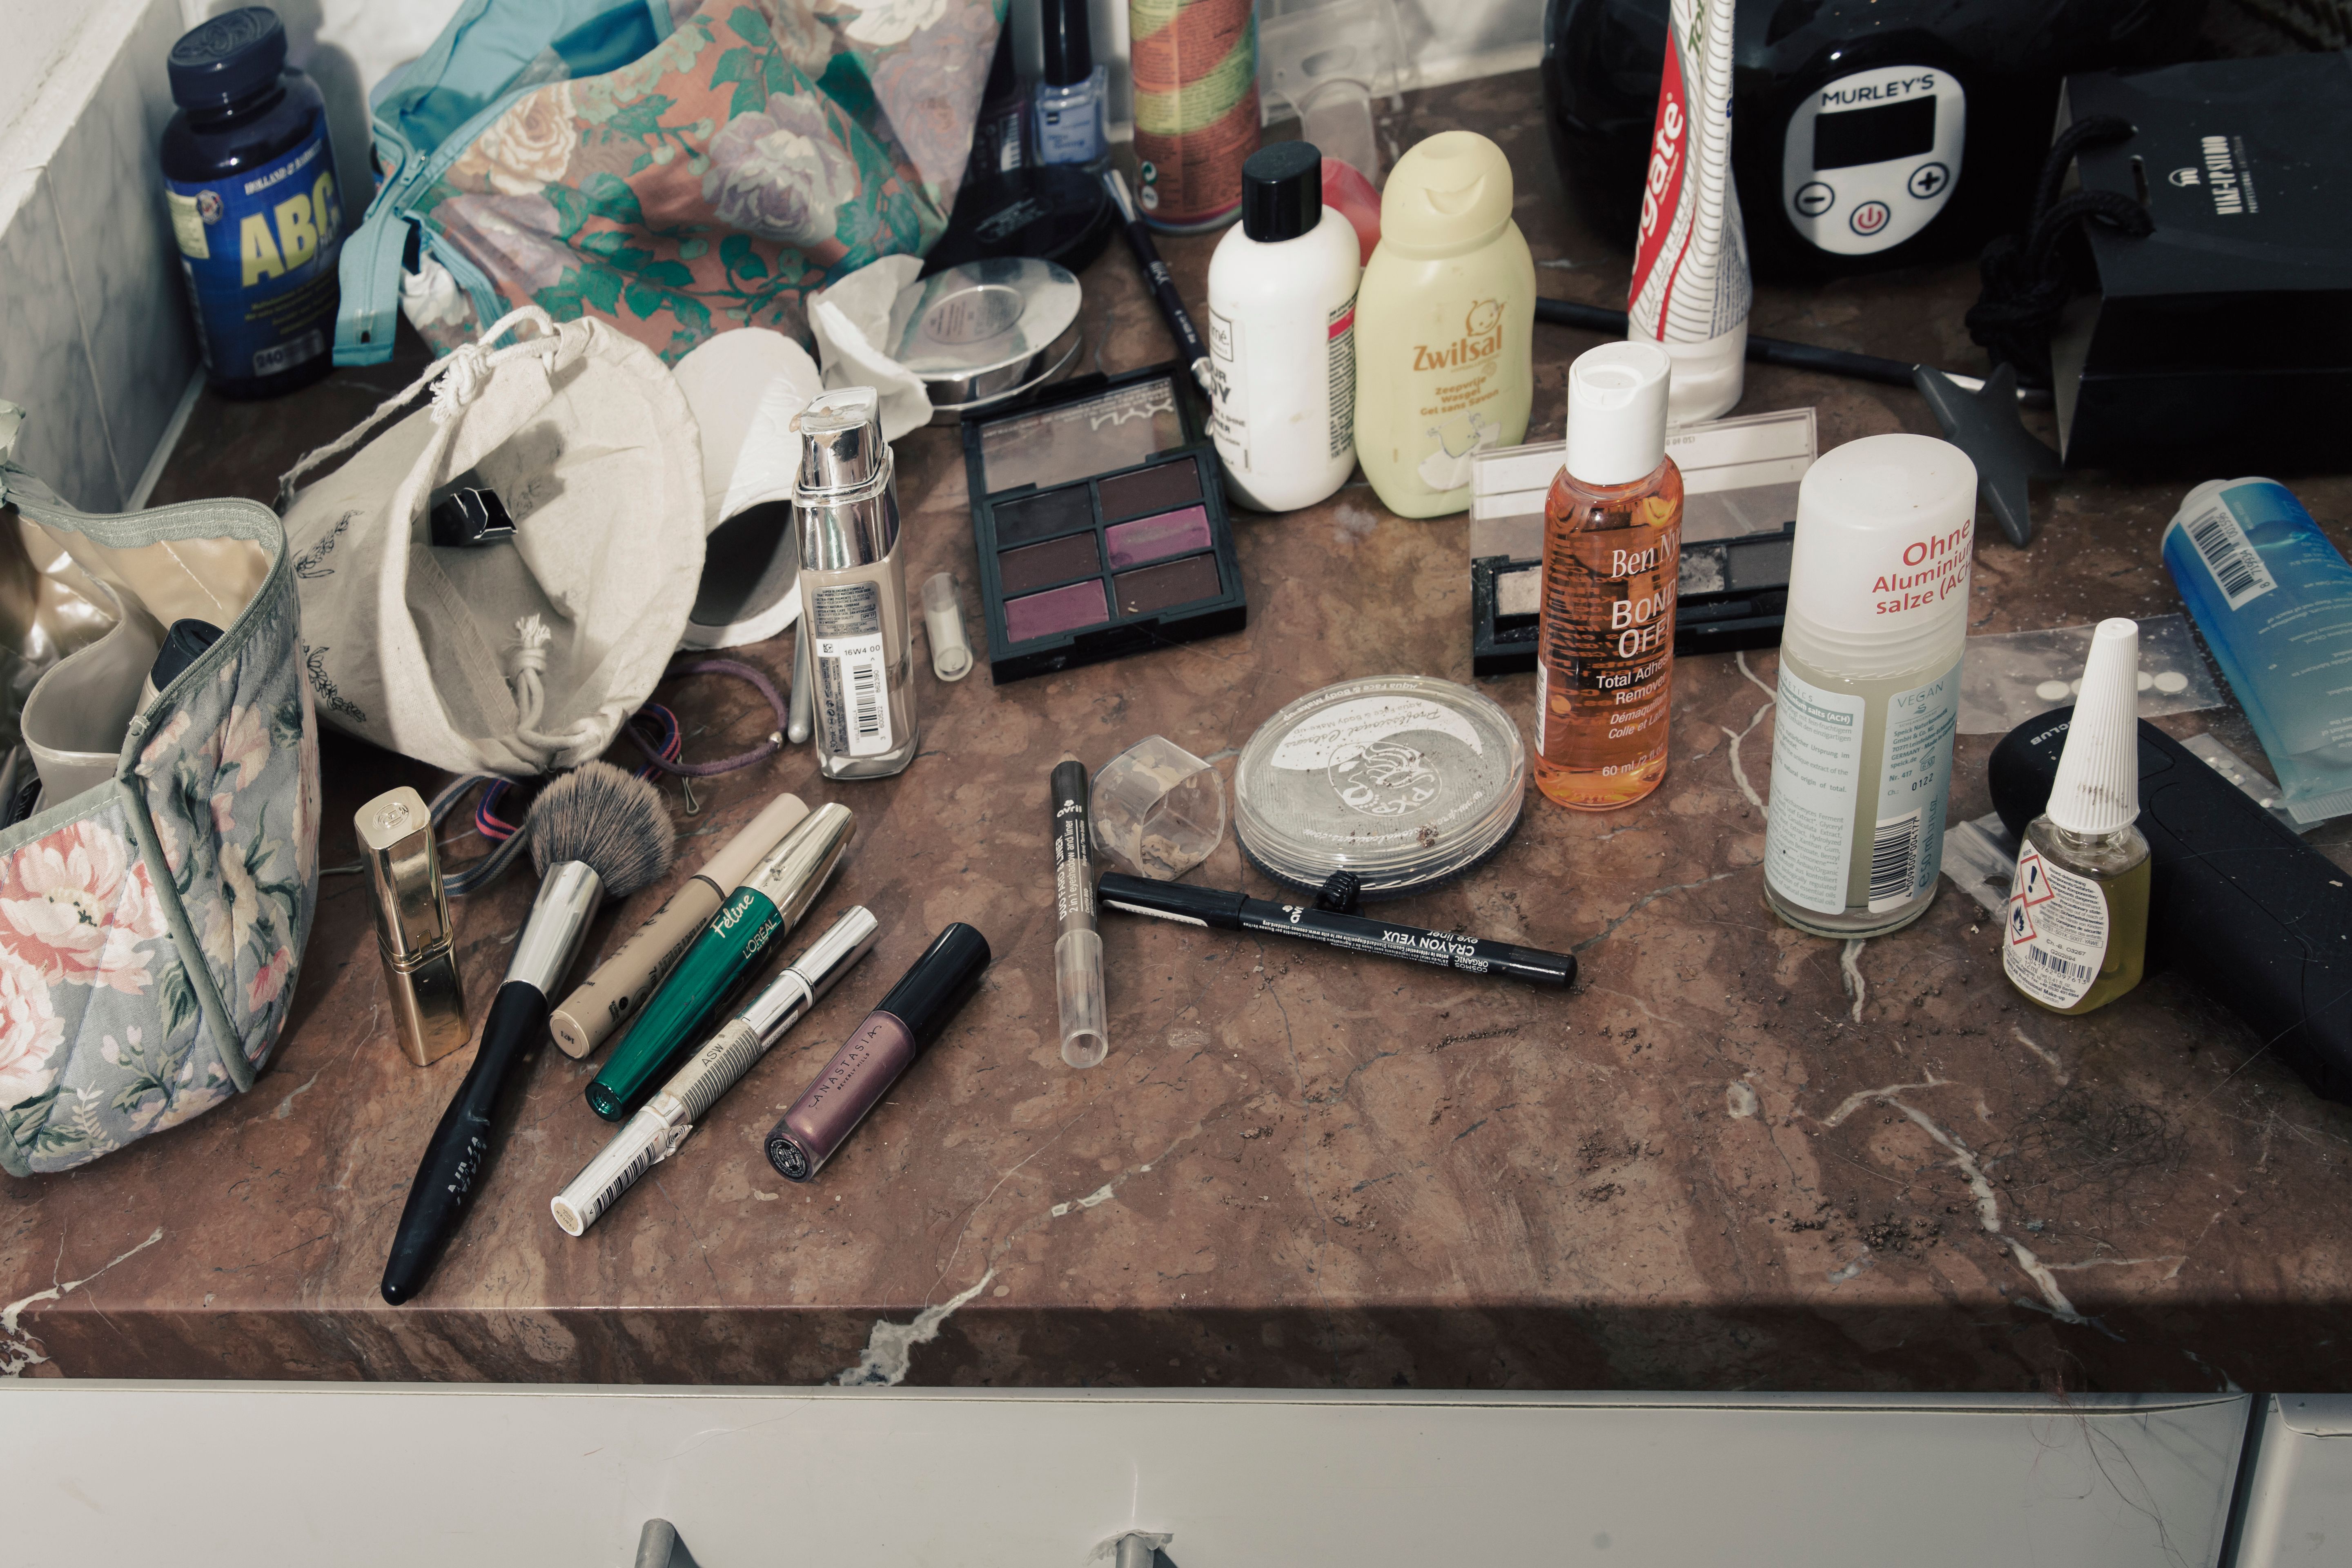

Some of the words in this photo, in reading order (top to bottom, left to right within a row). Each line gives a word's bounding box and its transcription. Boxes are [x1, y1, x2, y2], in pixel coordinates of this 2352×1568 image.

[1822, 74, 1936, 107] MURLEY'S
[240, 170, 341, 287] ABC
[1413, 325, 1503, 372] Zwitsal
[1903, 519, 1971, 566] Ohne
[1611, 549, 1656, 579] Ben
[1872, 535, 1974, 593] Aluminium
[2239, 548, 2261, 577] 719934
[1611, 577, 1676, 630] BOND
[1876, 590, 1934, 615] salze
[844, 646, 868, 656] 16W4
[870, 644, 881, 653] 00
[1363, 683, 1387, 693] Face
[1389, 682, 1417, 690] Aqua
[1596, 670, 1631, 689] Total
[1323, 686, 1350, 701] Body
[1615, 673, 1667, 705] Remover
[1897, 680, 1946, 708] VEGAN
[1281, 697, 1322, 722] Make-up
[1807, 707, 1826, 718] salts
[1826, 712, 1851, 725] (ACH)
[1608, 725, 1635, 740] Colle
[1637, 721, 1648, 733] et
[1812, 729, 1851, 744] einzigartigen
[1892, 735, 1912, 744] GmbH
[1893, 727, 1913, 737] Speick
[2029, 719, 2071, 746] CLUB
[1810, 745, 1838, 758] Ursprung
[1891, 746, 1921, 760] GERMANY
[1602, 764, 1617, 777] 60
[1810, 762, 1829, 773] extract
[1890, 756, 1918, 769] speick.de
[1800, 775, 1817, 787] origin
[1910, 772, 1935, 791] 0122
[1057, 804, 1082, 817] avril
[1818, 813, 1844, 824] Ferment
[1064, 820, 1073, 835] liner
[1818, 822, 1843, 832] Glyceryl
[1055, 835, 1064, 865] LINER
[1065, 837, 1074, 849] and
[1809, 835, 1842, 847] Hydrolyzed
[1922, 831, 1933, 853] ml
[1820, 853, 1840, 862] Benzyl
[1920, 852, 1932, 872] 50
[1067, 852, 1078, 892] eyeshadow
[1906, 855, 1915, 888] 009800
[1057, 871, 1066, 898] FARD
[1800, 884, 1824, 896] essential
[1808, 880, 1837, 891] regulated
[709, 893, 755, 941] Féline
[1058, 898, 1067, 921] DUO
[742, 919, 777, 959] L'ORÉAL
[1382, 930, 1417, 946] YEUX
[1426, 929, 1453, 941] liner
[1454, 934, 1478, 944] eye
[1405, 946, 1430, 955] référentiel
[1419, 937, 1475, 956] CRAYON
[1454, 956, 1488, 967] ORGANIC
[1454, 962, 1488, 972] COSMOS
[2042, 989, 2065, 1001] Make-up
[700, 1042, 724, 1067] ASW
[808, 1025, 881, 1109] ANASTASIA
[836, 1067, 857, 1091] BEVERLY
[856, 1051, 871, 1068] HILLS
